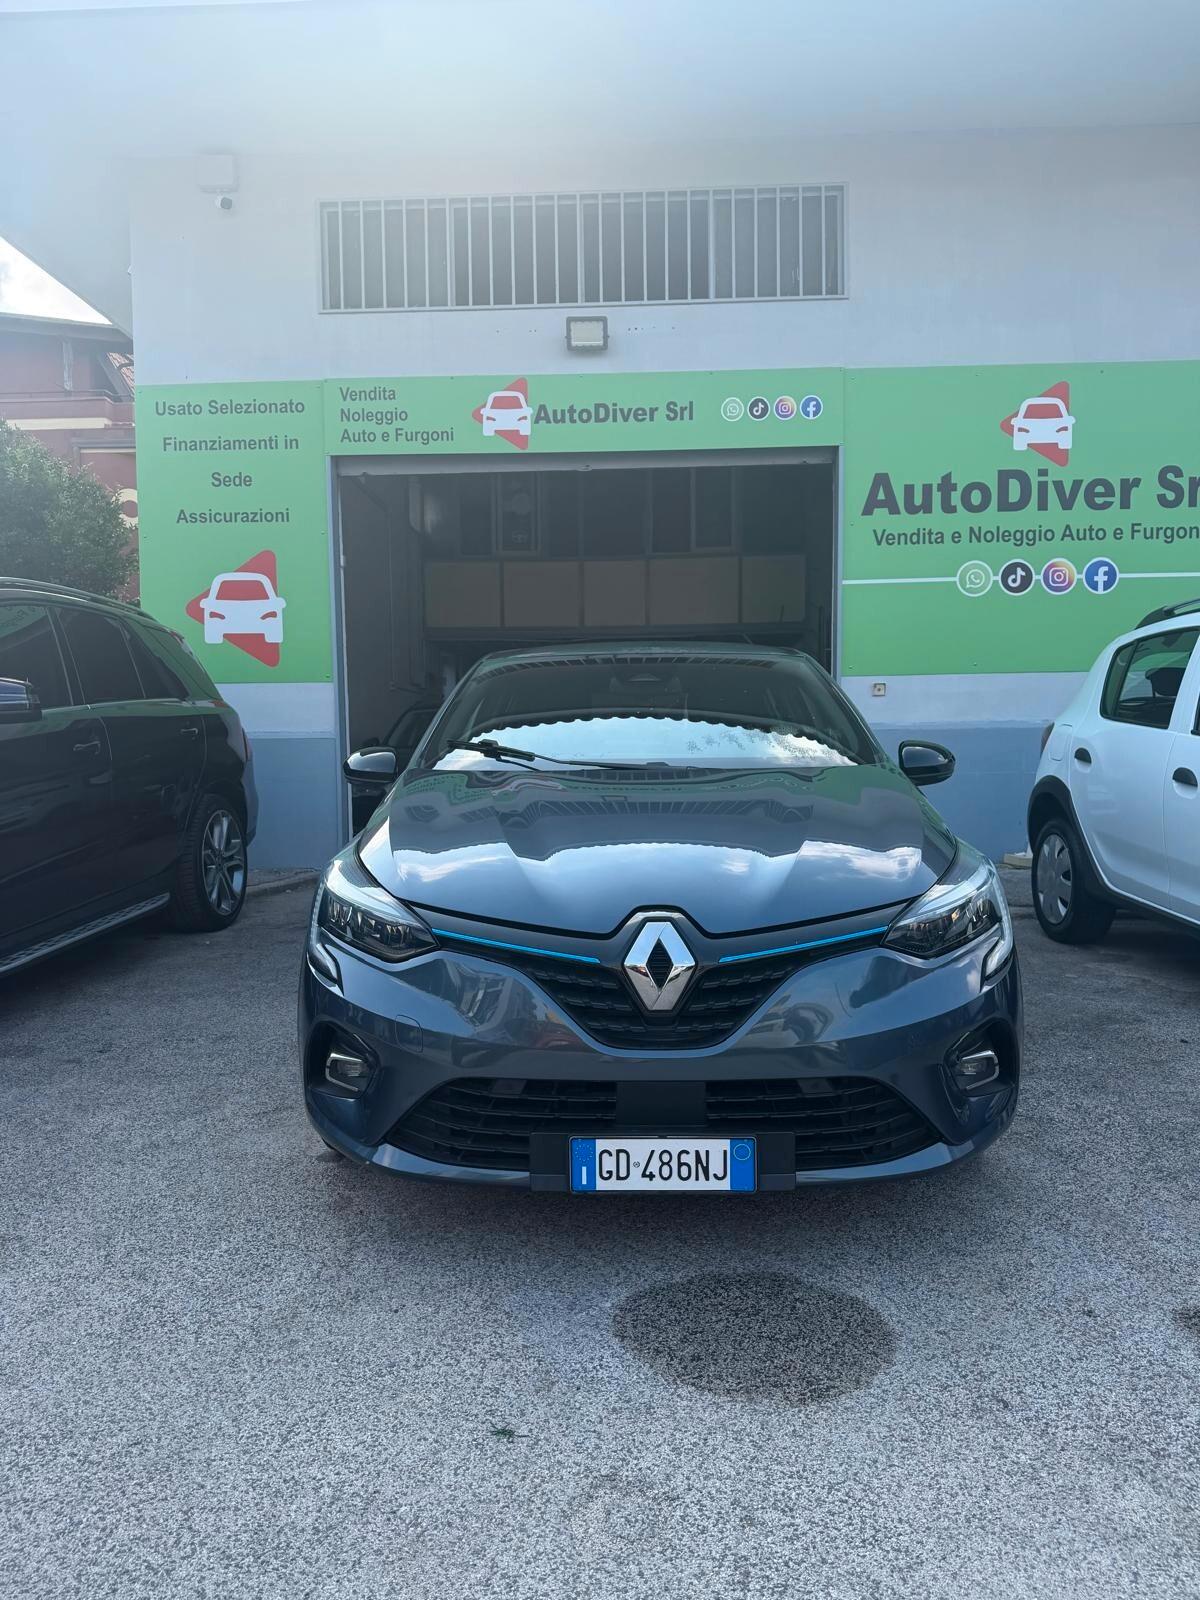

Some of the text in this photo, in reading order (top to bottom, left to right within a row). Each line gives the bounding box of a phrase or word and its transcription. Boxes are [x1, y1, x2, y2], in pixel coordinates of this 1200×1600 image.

[339, 386, 396, 402] Vendita
[155, 398, 305, 416] Usato Selezionato
[340, 407, 409, 425] Noleggio
[533, 400, 694, 425] AutoDiver Srl
[163, 436, 299, 452] Finanziamenti in
[340, 427, 454, 445] Auto e Furgoni
[211, 471, 253, 488] Sede
[860, 468, 1142, 516] AutoDiver
[176, 507, 290, 524] Assicurazioni
[872, 528, 945, 546] Vendita
[951, 530, 962, 544] e
[968, 524, 1055, 547] Noleggio
[1061, 523, 1107, 542] Auto
[1112, 526, 1124, 541] e
